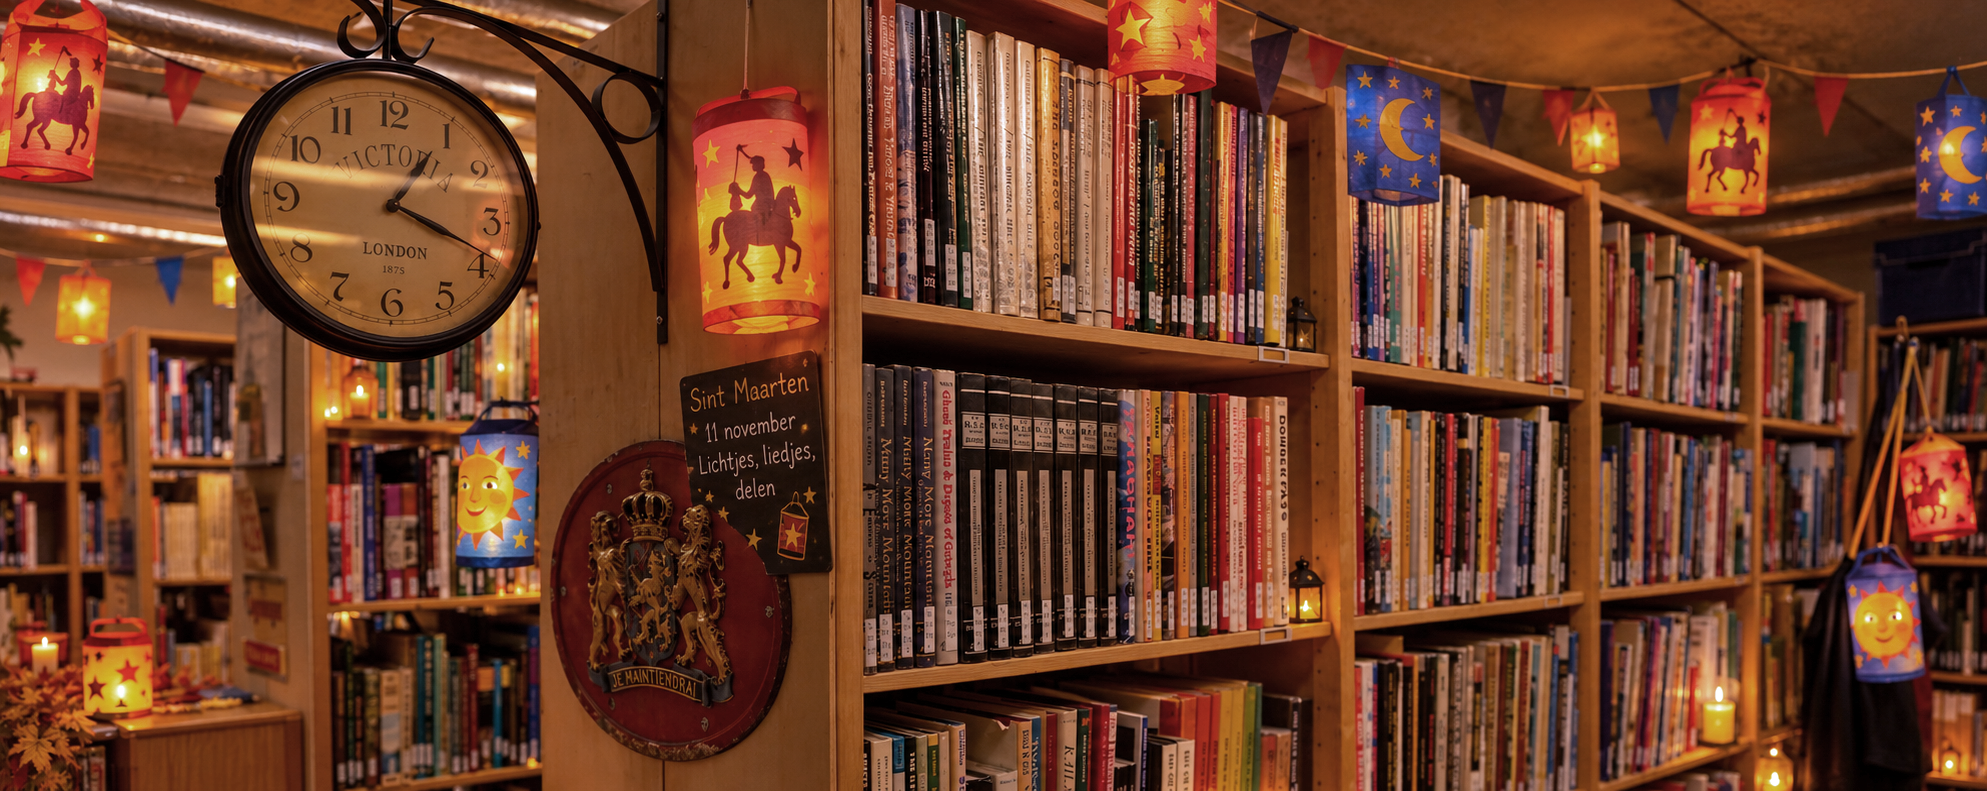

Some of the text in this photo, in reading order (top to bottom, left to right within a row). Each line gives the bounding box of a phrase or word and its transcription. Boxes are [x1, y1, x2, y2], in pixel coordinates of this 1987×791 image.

[331, 106, 352, 135] 11
[380, 100, 409, 130] 12
[290, 135, 321, 164] 10
[442, 123, 451, 149] 1
[470, 160, 489, 189] 2
[273, 181, 300, 212] 9
[483, 207, 501, 236] 3
[290, 233, 313, 263] 8
[363, 241, 428, 260] LONDON
[467, 252, 490, 279] 4
[330, 271, 350, 302] 7
[435, 281, 454, 311] 5
[380, 288, 404, 317] 6
[690, 372, 809, 412] Sint Maarten
[704, 411, 796, 443] 11 november
[698, 441, 816, 477] Lichtjes, liedjes,
[735, 478, 776, 500] delen
[612, 668, 696, 698] JE MAINTIENDRAI
